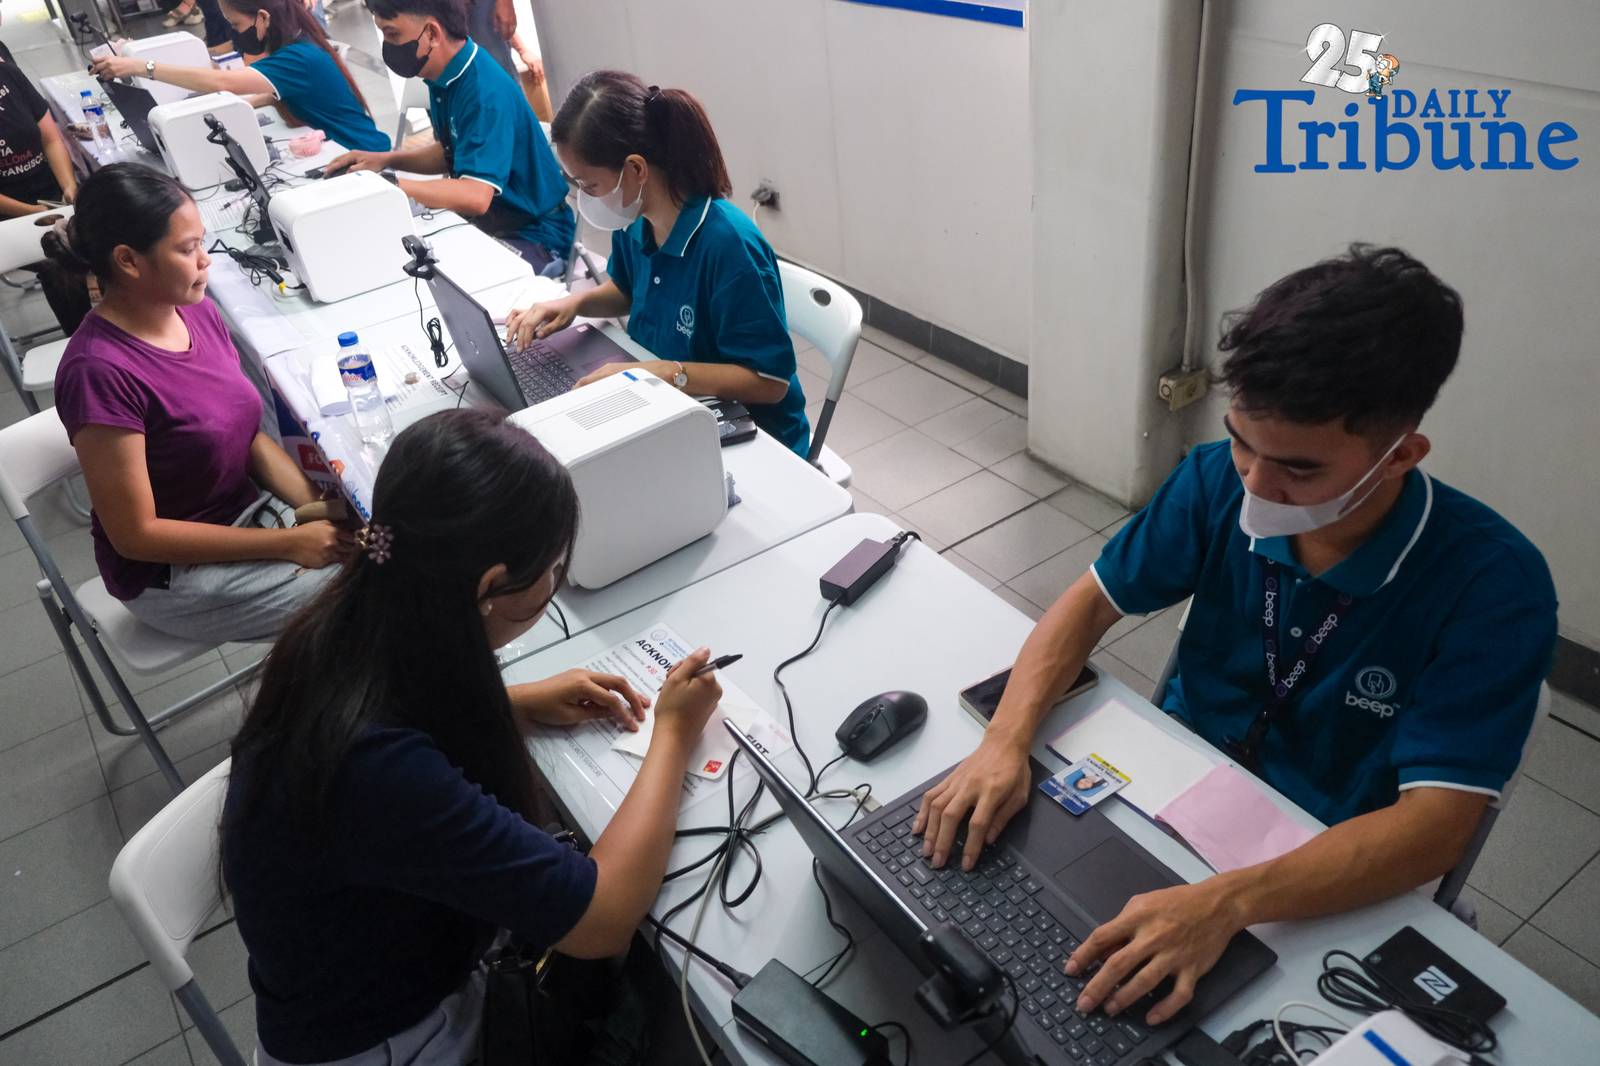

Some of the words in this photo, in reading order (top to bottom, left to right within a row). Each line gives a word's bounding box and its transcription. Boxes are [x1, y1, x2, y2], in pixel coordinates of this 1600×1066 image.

[1263, 591, 1277, 627] beep
[1310, 613, 1338, 645] beep
[635, 639, 673, 672] ACKNOW
[1266, 652, 1276, 686] beep
[1281, 660, 1306, 689] beep
[1345, 690, 1394, 718] beep
